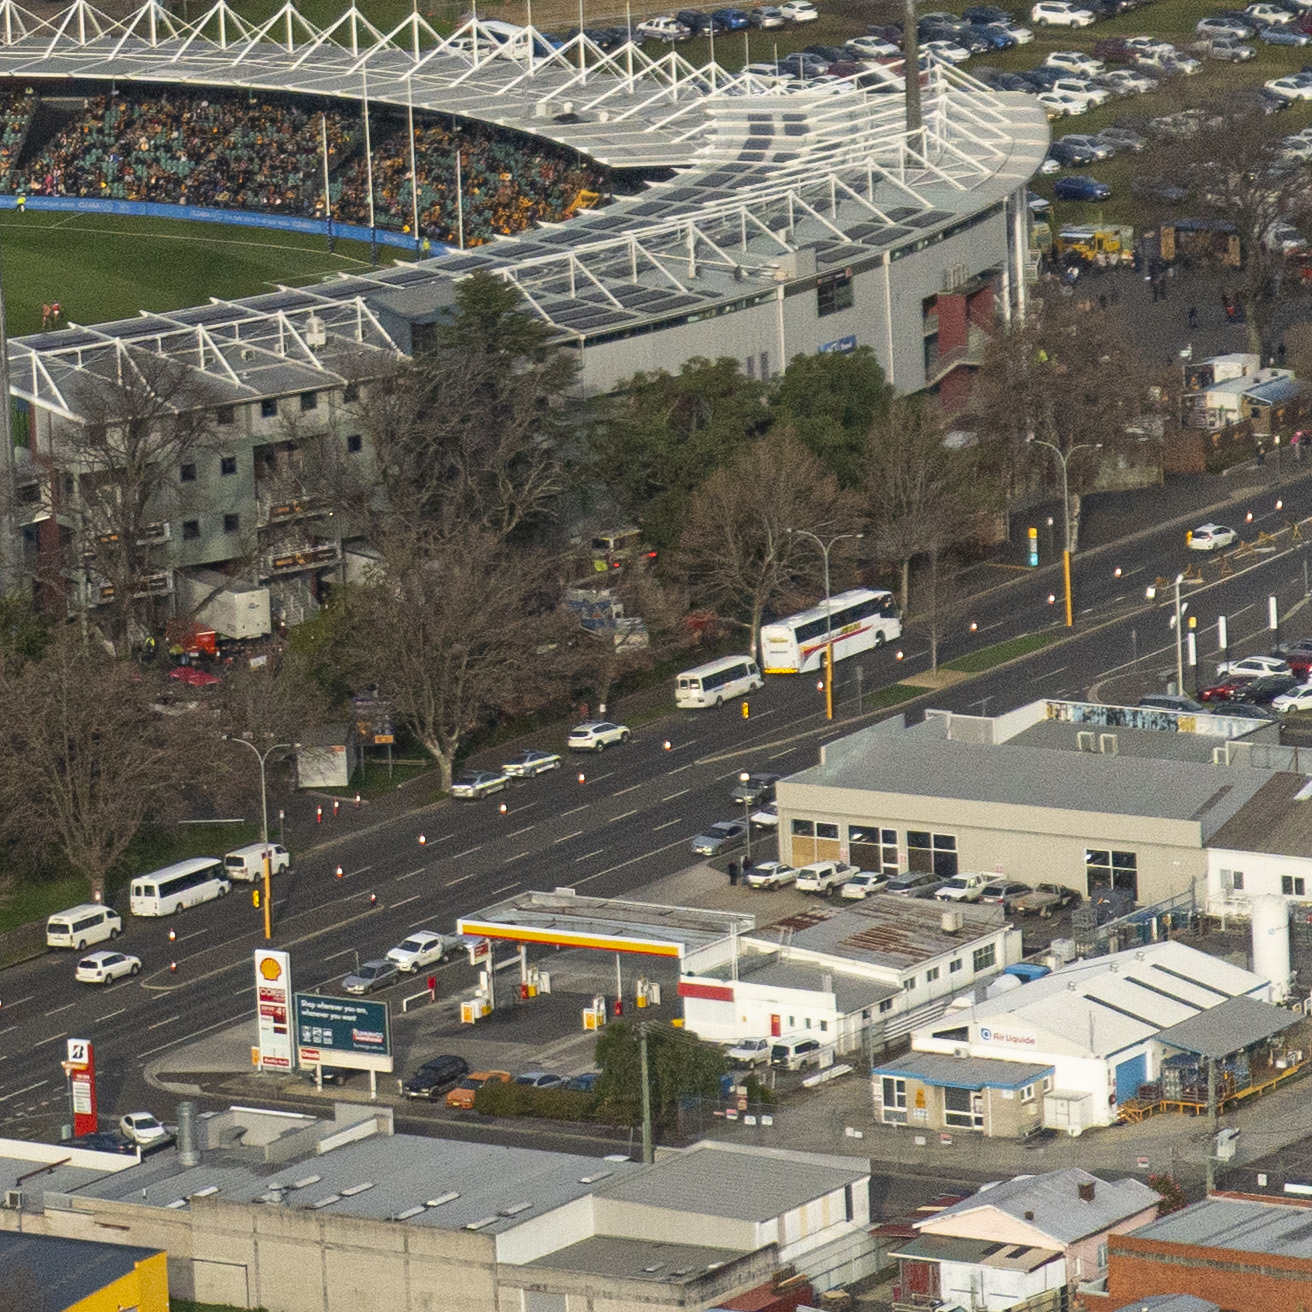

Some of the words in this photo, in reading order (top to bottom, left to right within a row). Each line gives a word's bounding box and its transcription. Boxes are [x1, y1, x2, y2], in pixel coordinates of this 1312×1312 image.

[300, 999, 316, 1010] Shop
[993, 1032, 1005, 1041] Air
[1006, 1033, 1036, 1045] Liquide
